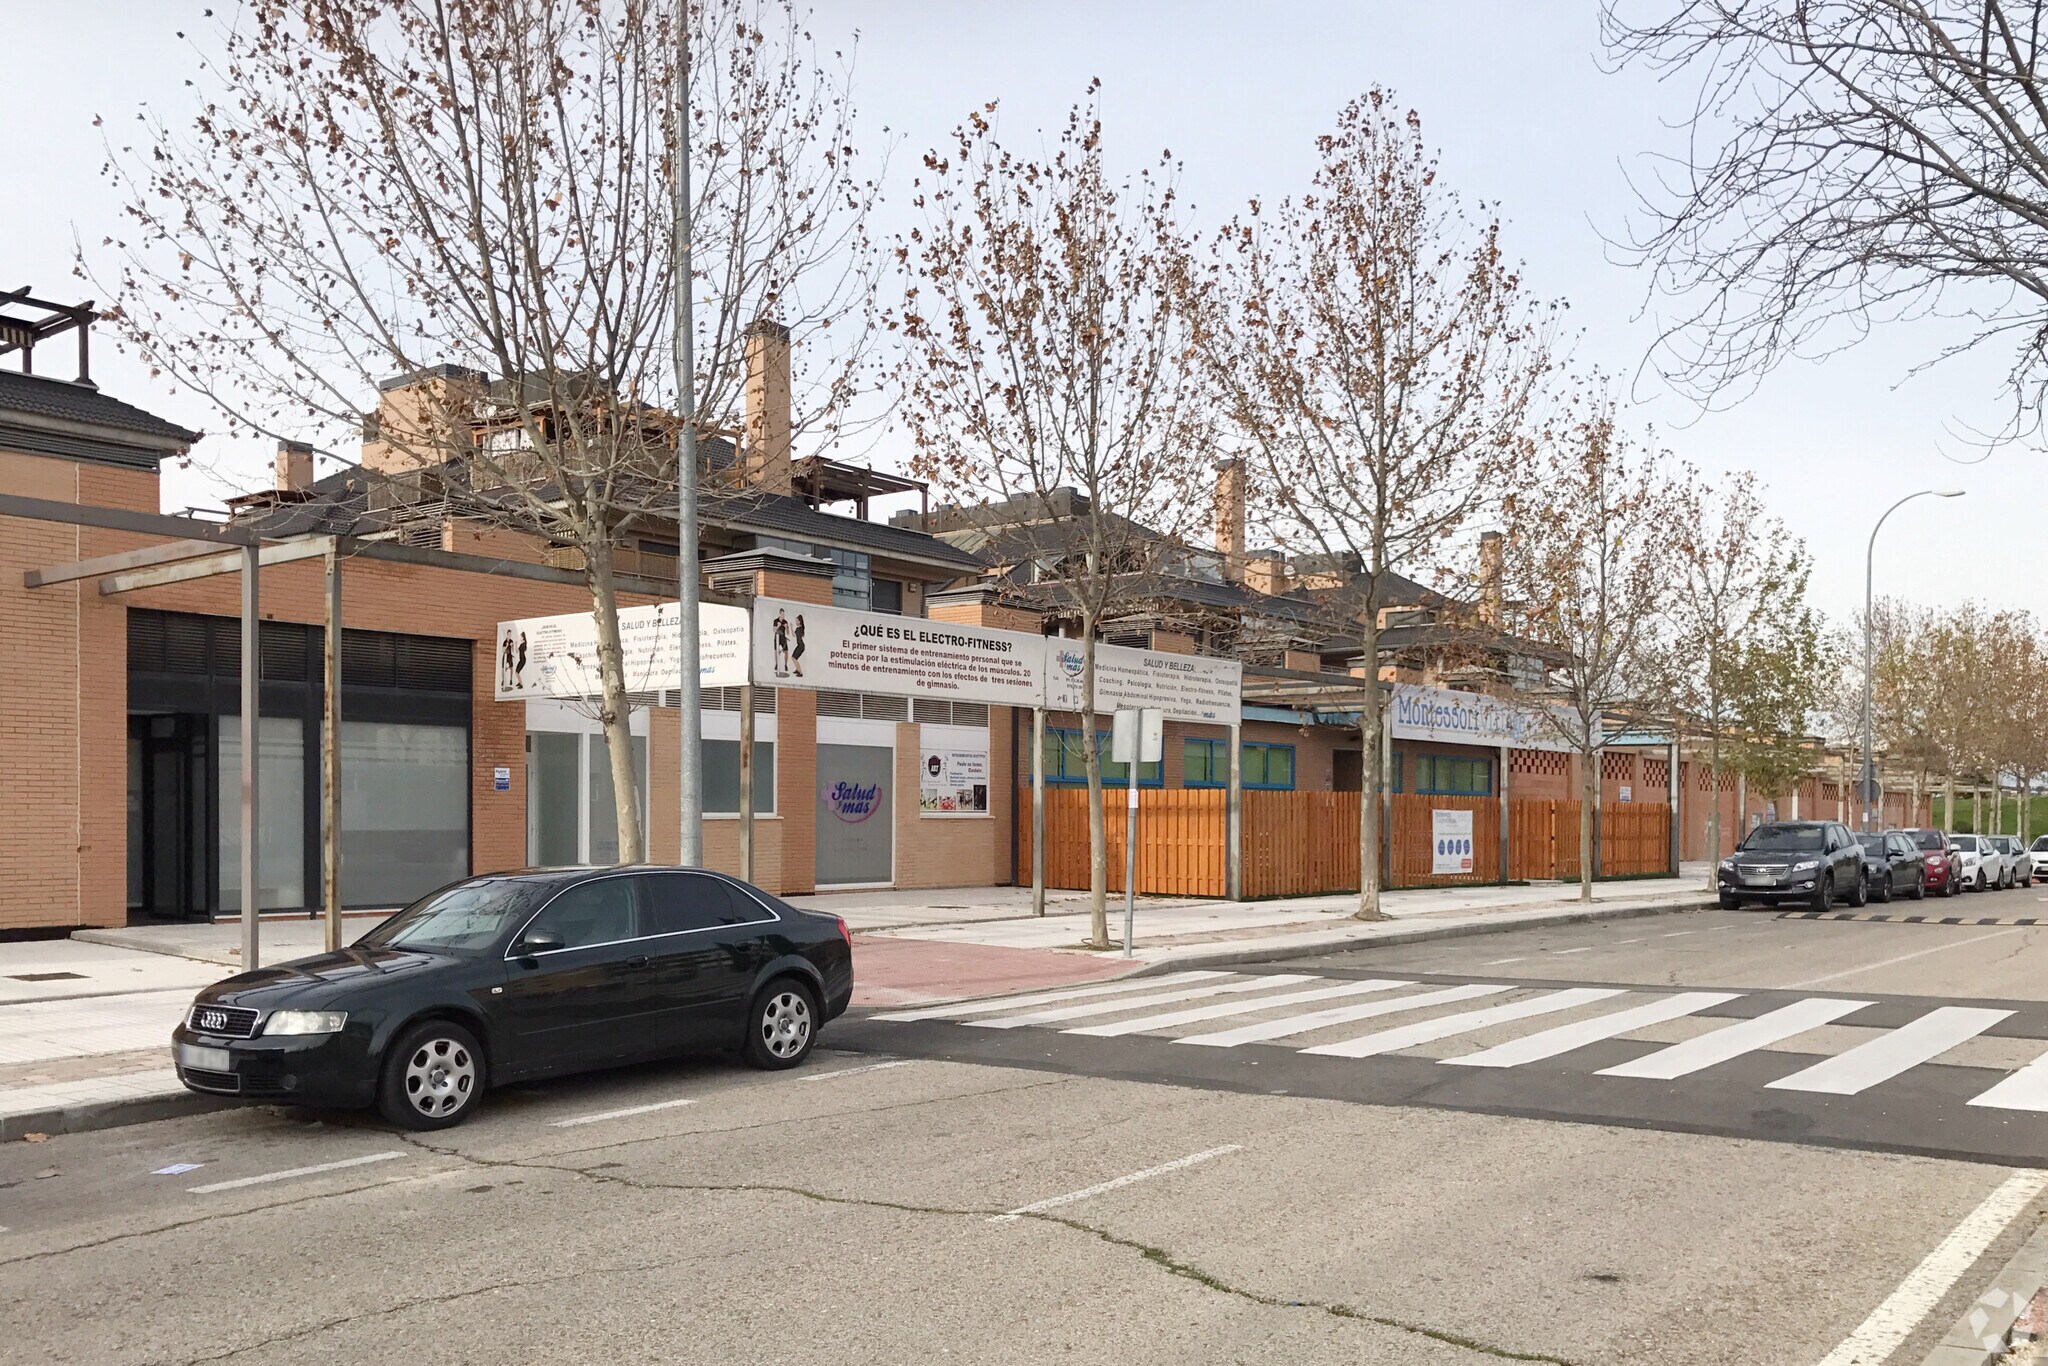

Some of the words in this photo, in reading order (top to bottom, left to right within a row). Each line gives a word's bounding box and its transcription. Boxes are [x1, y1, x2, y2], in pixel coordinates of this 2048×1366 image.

[622, 620, 644, 630] SALUD
[646, 620, 652, 628] Y
[854, 624, 884, 638] ¿QUÉ
[886, 628, 900, 640] ES
[904, 630, 916, 641] EL
[920, 631, 1012, 652] ELECTRO-FITNESS?
[830, 650, 864, 660] potencia
[866, 655, 880, 663] por
[890, 657, 936, 668] estimulación
[937, 660, 967, 671] eléctrica
[978, 665, 988, 673] los
[1024, 669, 1032, 678] 20
[842, 640, 850, 648] El
[852, 642, 877, 652] primer
[879, 644, 908, 654] sistema
[910, 647, 919, 656] de
[920, 650, 970, 661] entrenamiento
[972, 655, 1000, 665] personal
[1001, 659, 1014, 667] que
[1062, 652, 1084, 664] Salud
[1144, 658, 1164, 669] SALUD
[1164, 661, 1169, 669] Y
[828, 660, 859, 671] minutos
[861, 663, 871, 672] de
[872, 665, 926, 677] entrenamiento
[942, 671, 952, 680] los
[954, 672, 978, 682] efectos
[980, 674, 988, 683] de
[991, 676, 1004, 685] tres
[1006, 678, 1033, 688] sesiones
[916, 678, 926, 687] de
[926, 679, 960, 690] gimnasio.
[1398, 694, 1480, 731] Montessori
[832, 782, 876, 800] Salud
